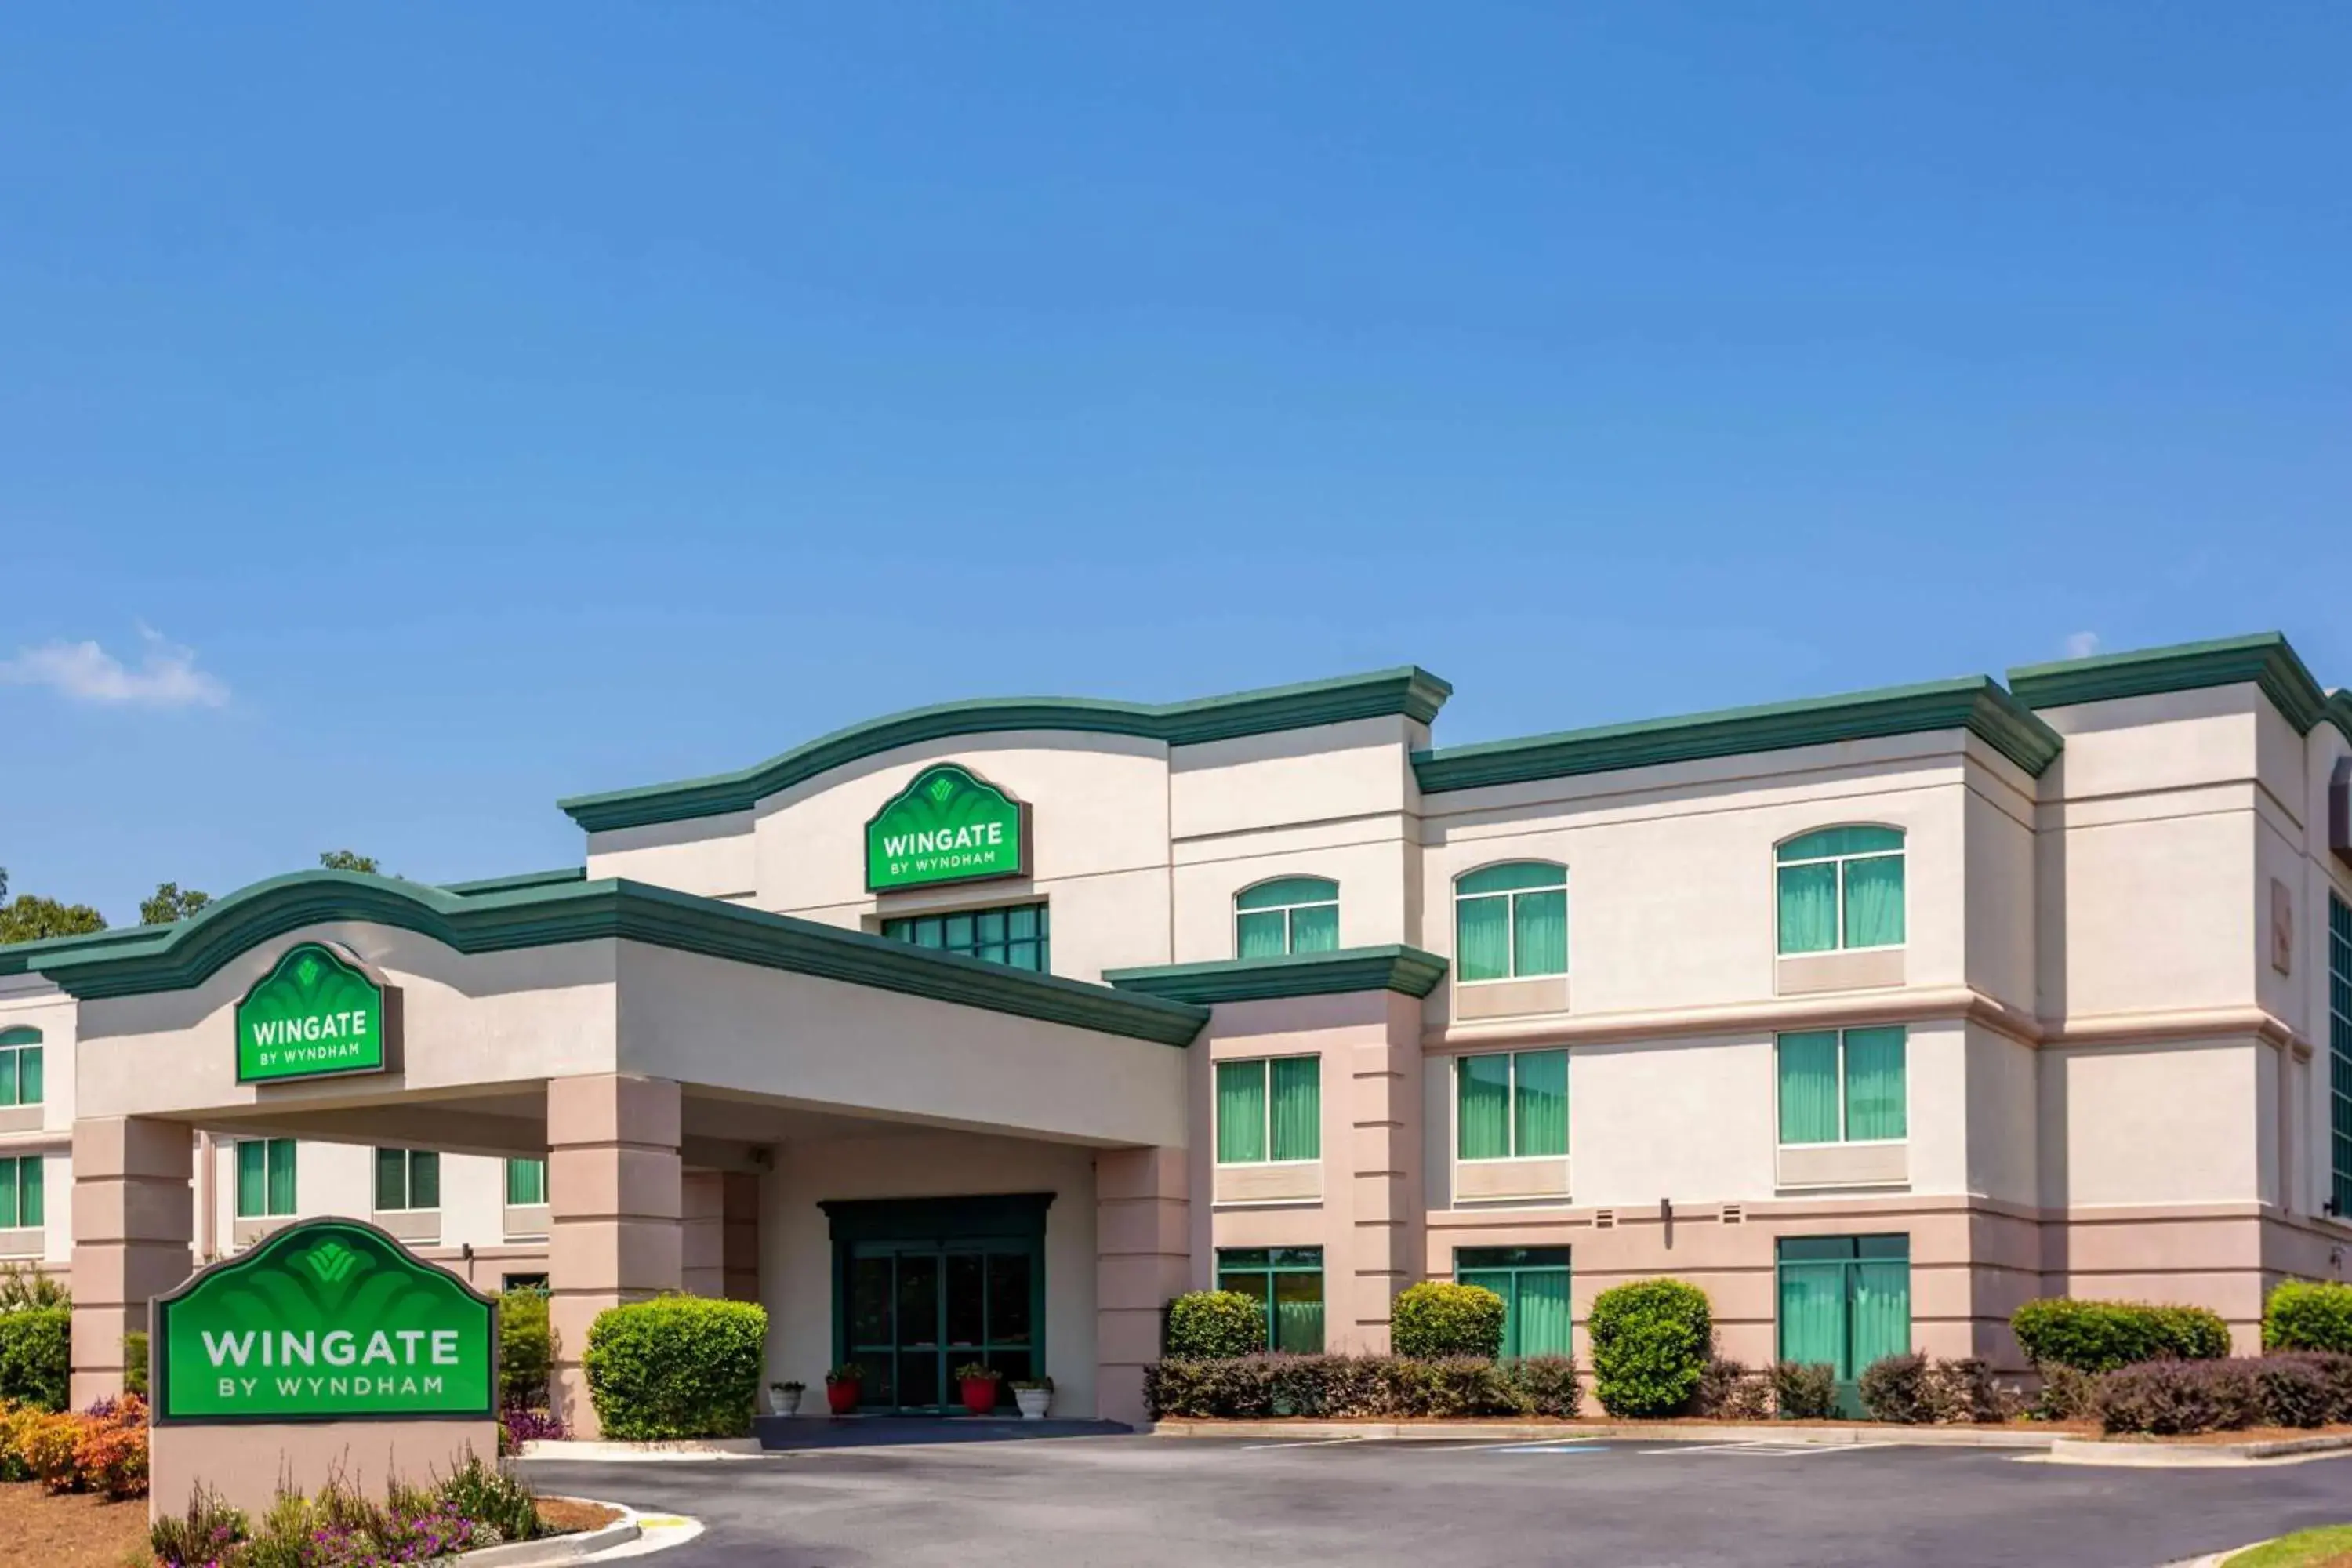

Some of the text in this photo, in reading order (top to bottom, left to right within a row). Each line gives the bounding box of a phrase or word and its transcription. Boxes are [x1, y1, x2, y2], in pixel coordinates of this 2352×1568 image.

[883, 822, 1003, 858] WINGATE
[891, 851, 996, 875] BY WYNDHAM
[253, 1010, 366, 1047] WINGATE
[260, 1042, 359, 1065] BY WYNDHAM
[201, 1330, 459, 1367] WINGATE
[218, 1376, 444, 1396] BY WYNDHAM
